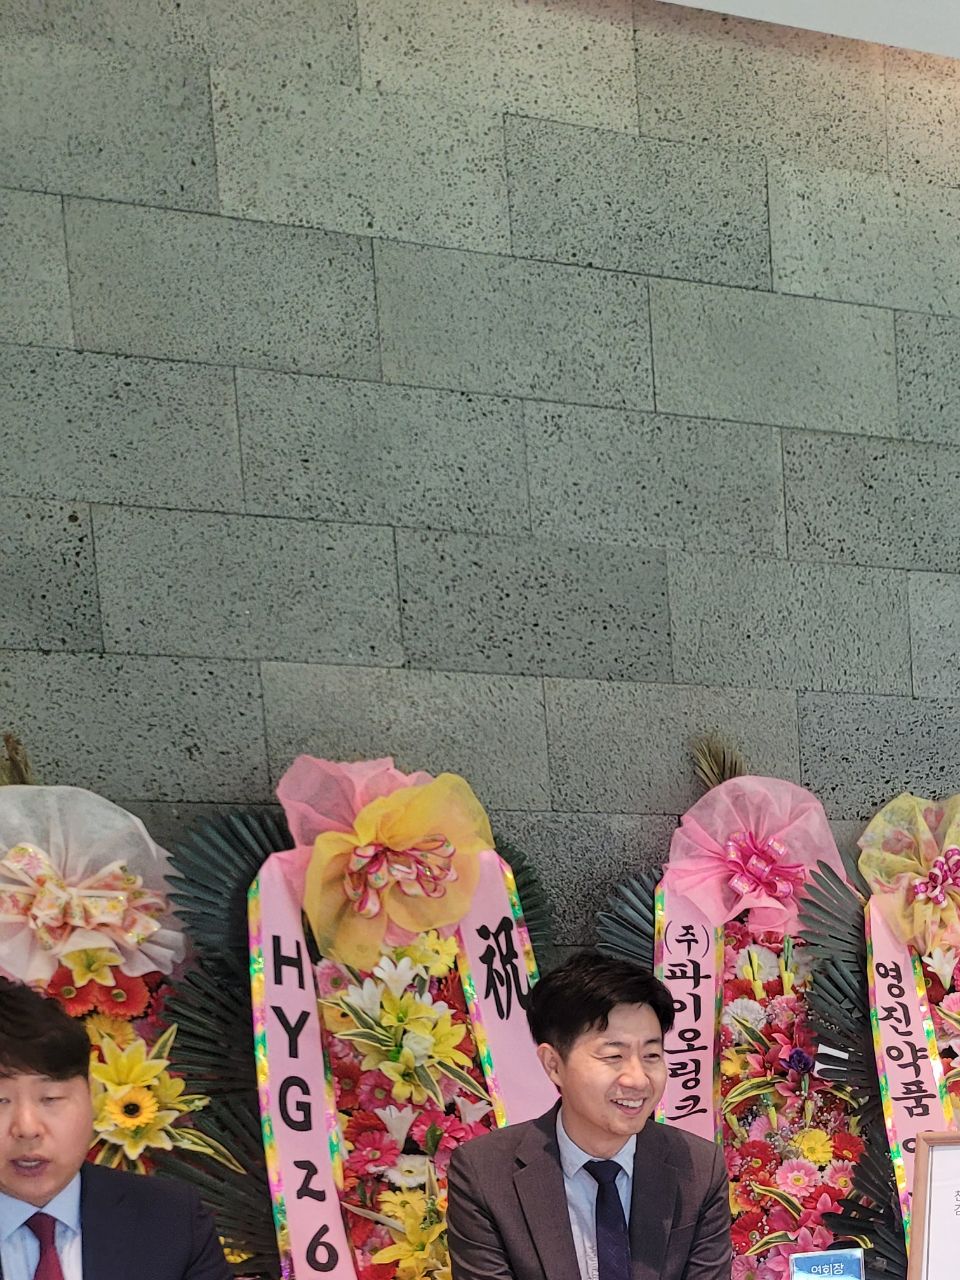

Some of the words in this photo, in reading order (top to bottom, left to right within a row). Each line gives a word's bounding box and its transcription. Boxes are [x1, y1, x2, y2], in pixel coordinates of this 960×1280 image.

[475, 915, 533, 1021] 祝
[664, 919, 712, 1121] (주)파이오링크
[875, 961, 937, 1118] 영진약품
